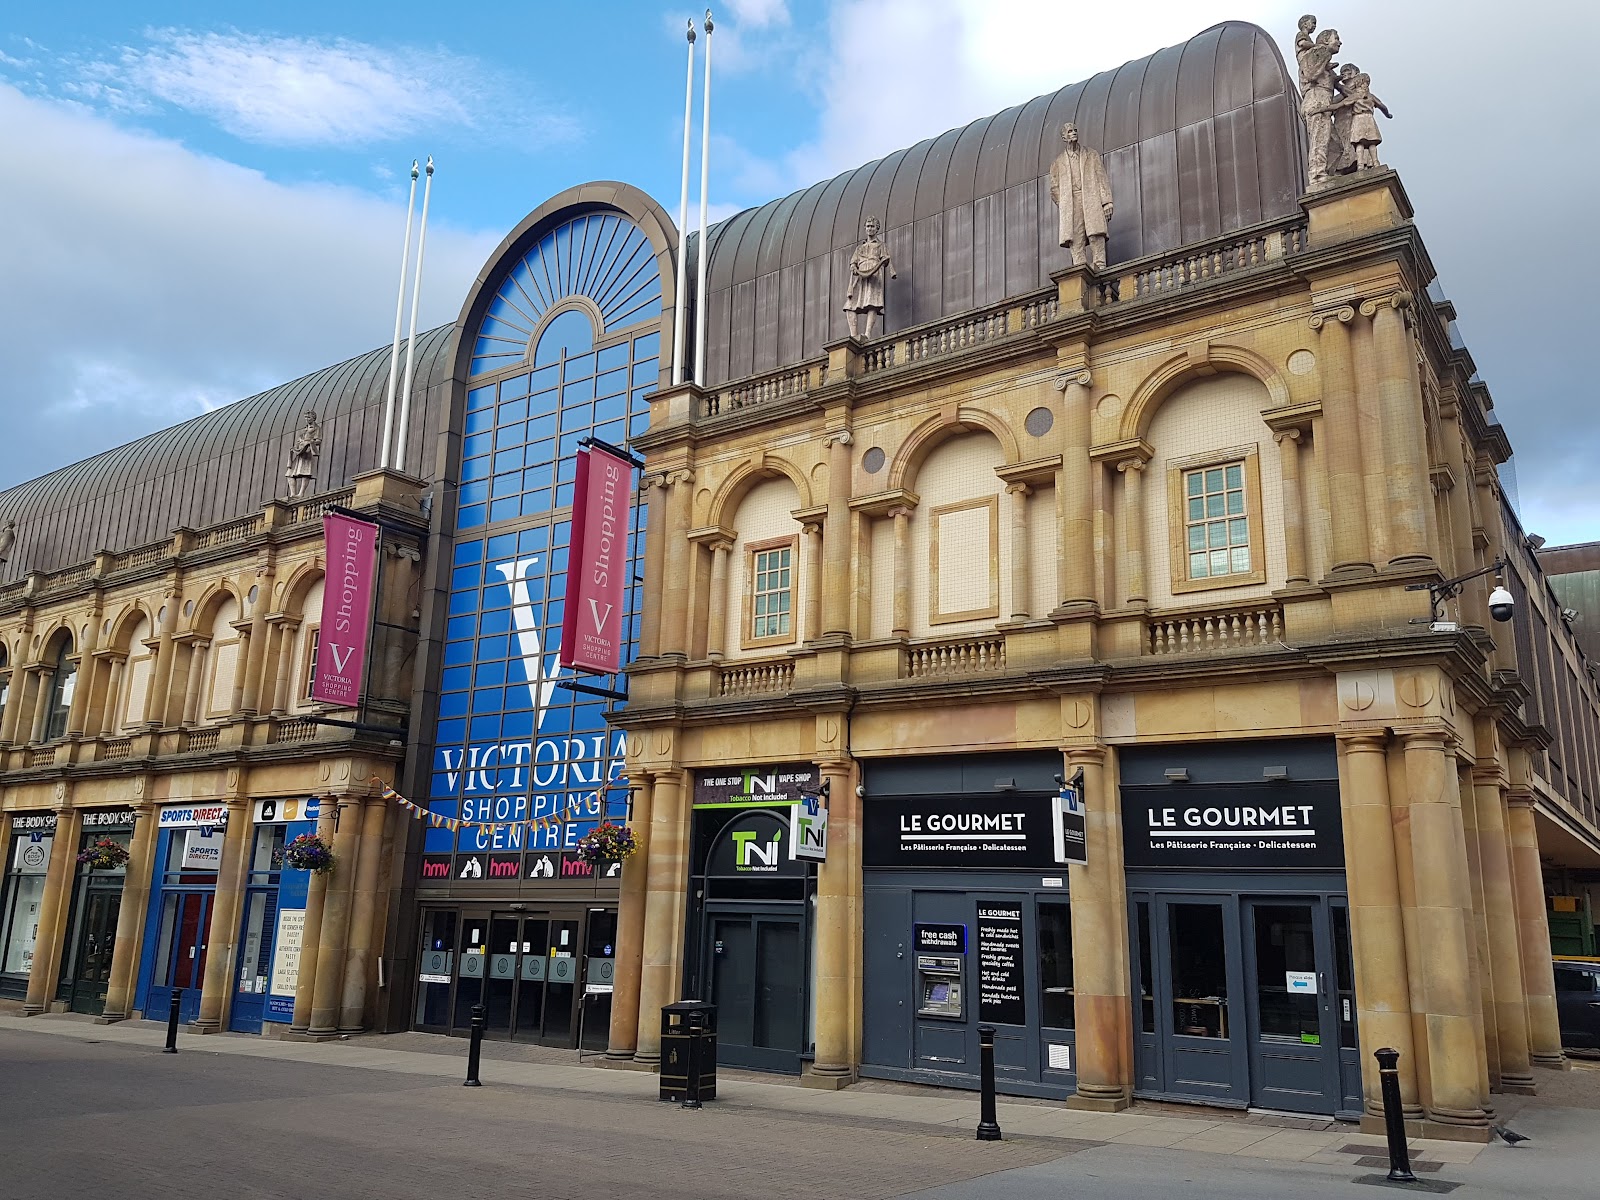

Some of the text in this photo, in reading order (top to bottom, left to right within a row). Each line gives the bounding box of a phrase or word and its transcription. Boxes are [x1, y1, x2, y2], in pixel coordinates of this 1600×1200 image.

[594, 463, 620, 588] Shopping
[336, 526, 363, 633] Shopping
[588, 598, 613, 636] V
[496, 557, 562, 730] V
[584, 634, 611, 647] VICTORIA
[582, 643, 611, 656] SHOPPING
[328, 642, 356, 674] V
[586, 652, 608, 662] CENTRE
[324, 674, 352, 684] VICTORIA
[322, 681, 352, 692] SHOPPING
[324, 688, 348, 698] CENTRE
[442, 733, 628, 792] VICTORIA
[704, 777, 742, 786] THE ONE STOP
[779, 774, 811, 782] VAPE SHOP
[462, 791, 600, 821] SHOPPING
[13, 817, 26, 828] THE
[26, 816, 44, 828] BODY
[83, 814, 98, 826] THE
[98, 812, 118, 825] BODY
[161, 810, 192, 822] SPORTS
[1148, 806, 1313, 827] LE GOURMET
[901, 814, 1026, 832] LE GOURMET
[476, 823, 578, 850] CENTRE
[914, 843, 943, 851] Pâtisserie
[946, 843, 977, 852] Française
[1150, 840, 1316, 850] Les Pâtisserie Française Delicatessen
[423, 860, 450, 877] hmv
[490, 859, 519, 876] hmv
[562, 859, 592, 875] hmv
[921, 930, 957, 940] free cash
[921, 938, 957, 946] withdrawals
